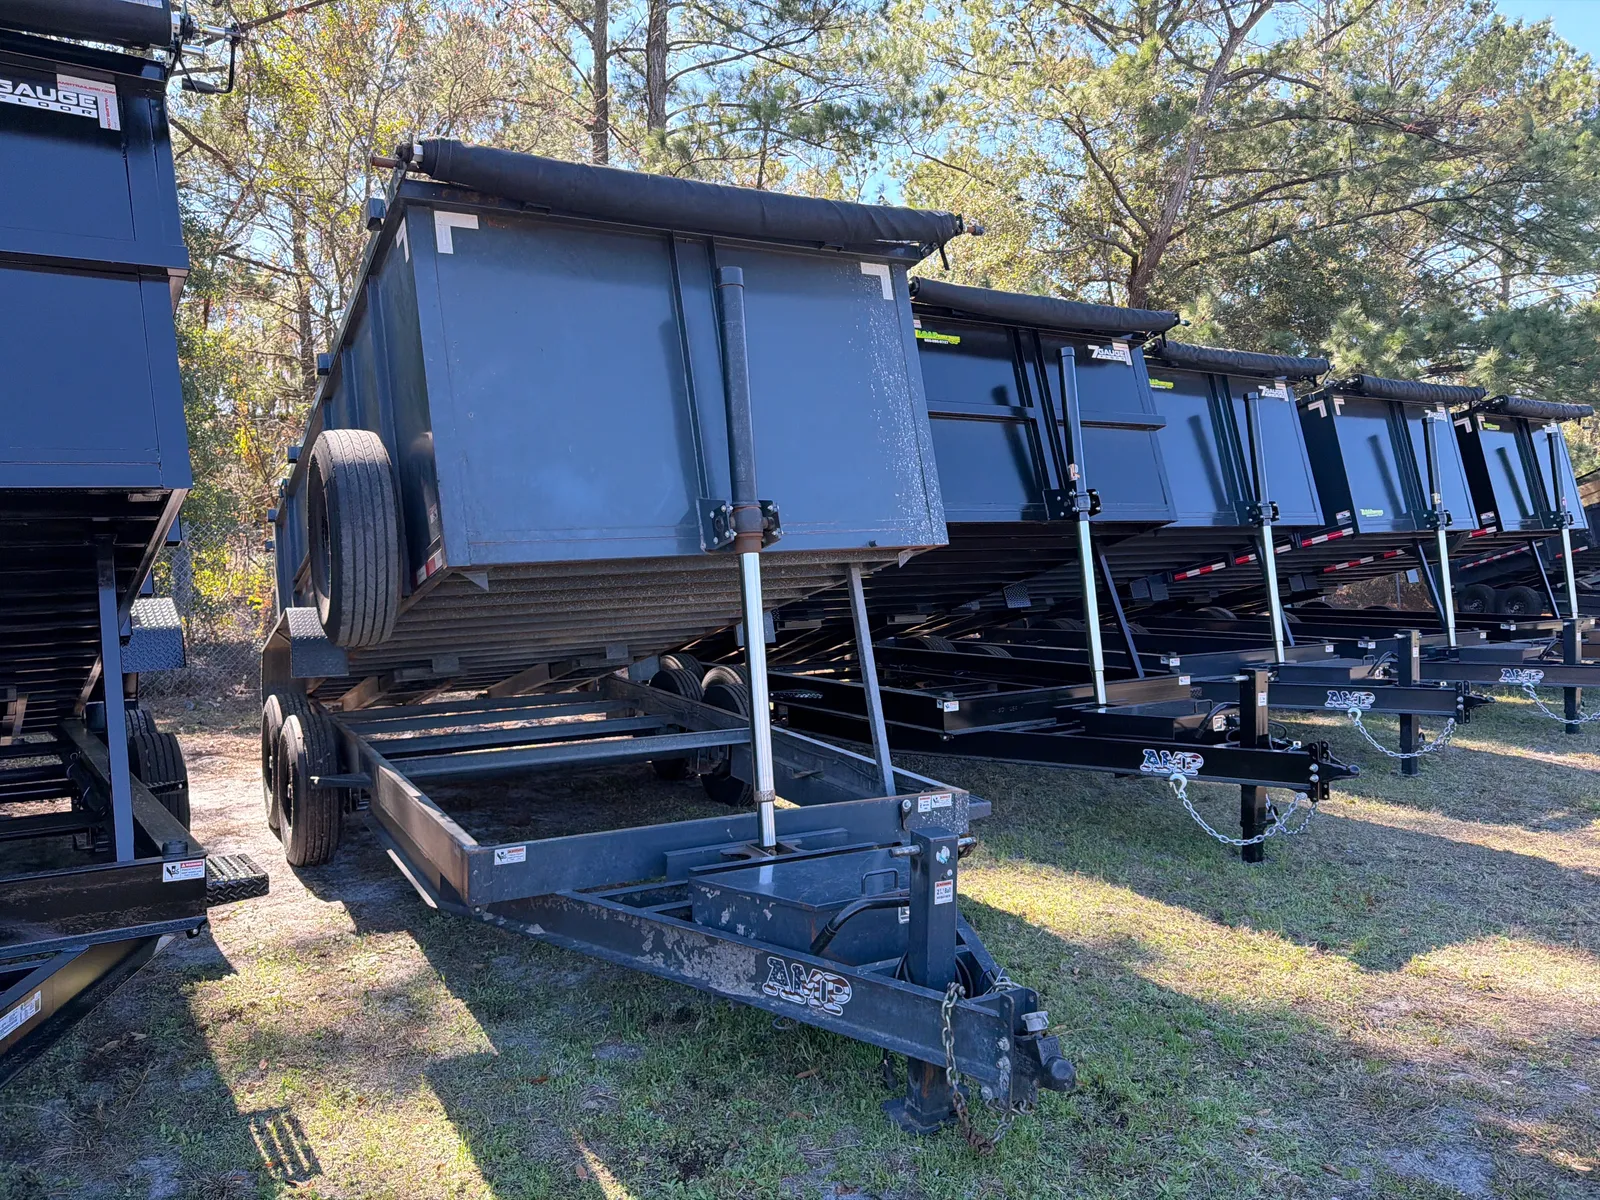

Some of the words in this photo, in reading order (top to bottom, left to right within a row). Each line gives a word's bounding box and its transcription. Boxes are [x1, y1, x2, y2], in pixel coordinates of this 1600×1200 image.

[1088, 345, 1099, 358] 7
[1099, 349, 1125, 357] GAUGE
[1325, 690, 1376, 709] AMP
[1140, 749, 1204, 775] AMP
[762, 956, 852, 1016] AMP
